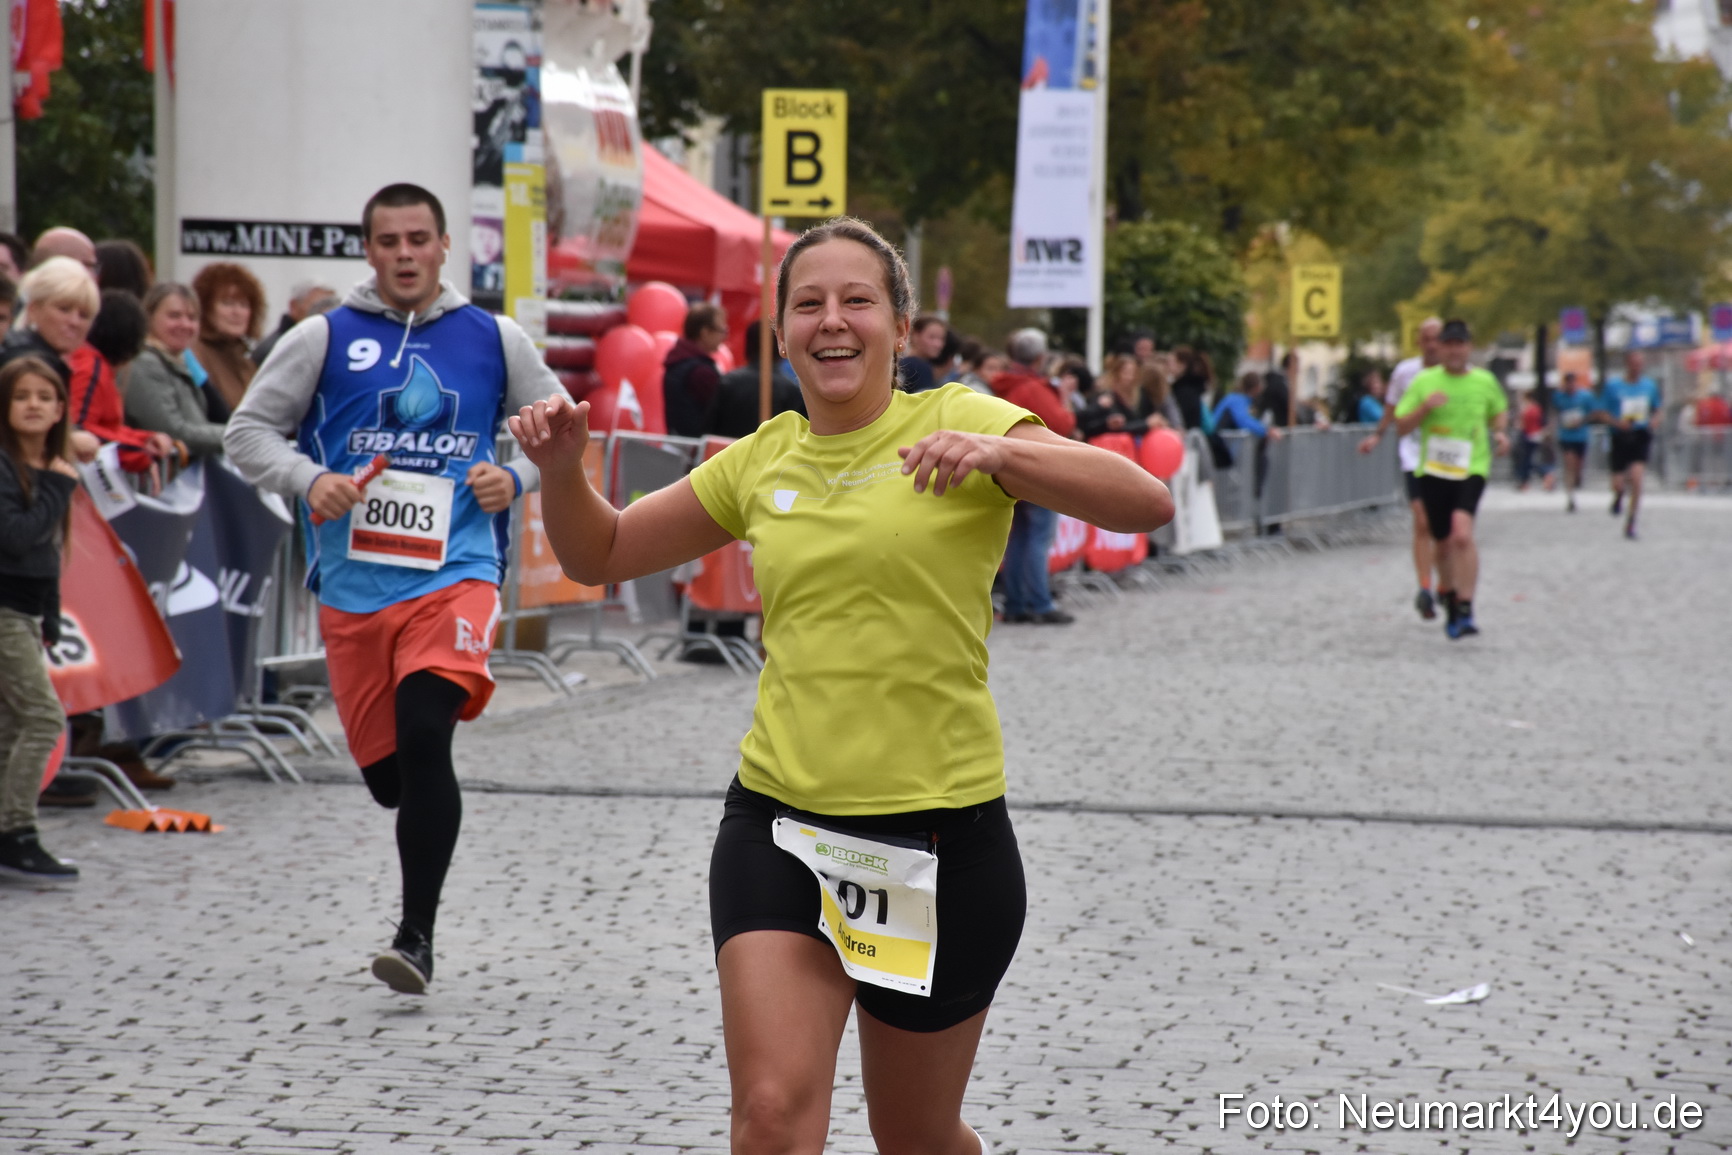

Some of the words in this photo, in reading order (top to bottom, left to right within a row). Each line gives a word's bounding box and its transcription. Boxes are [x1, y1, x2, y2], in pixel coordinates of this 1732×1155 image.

[773, 96, 836, 119] Block
[786, 129, 823, 187] B
[1303, 285, 1327, 320] C
[347, 338, 382, 372] 9
[351, 431, 477, 458] FIBALON
[391, 457, 440, 469] ASKETS
[365, 498, 434, 532] 8003
[832, 846, 889, 871] BOCK
[836, 879, 888, 925] 01
[838, 921, 876, 957] Andrea
